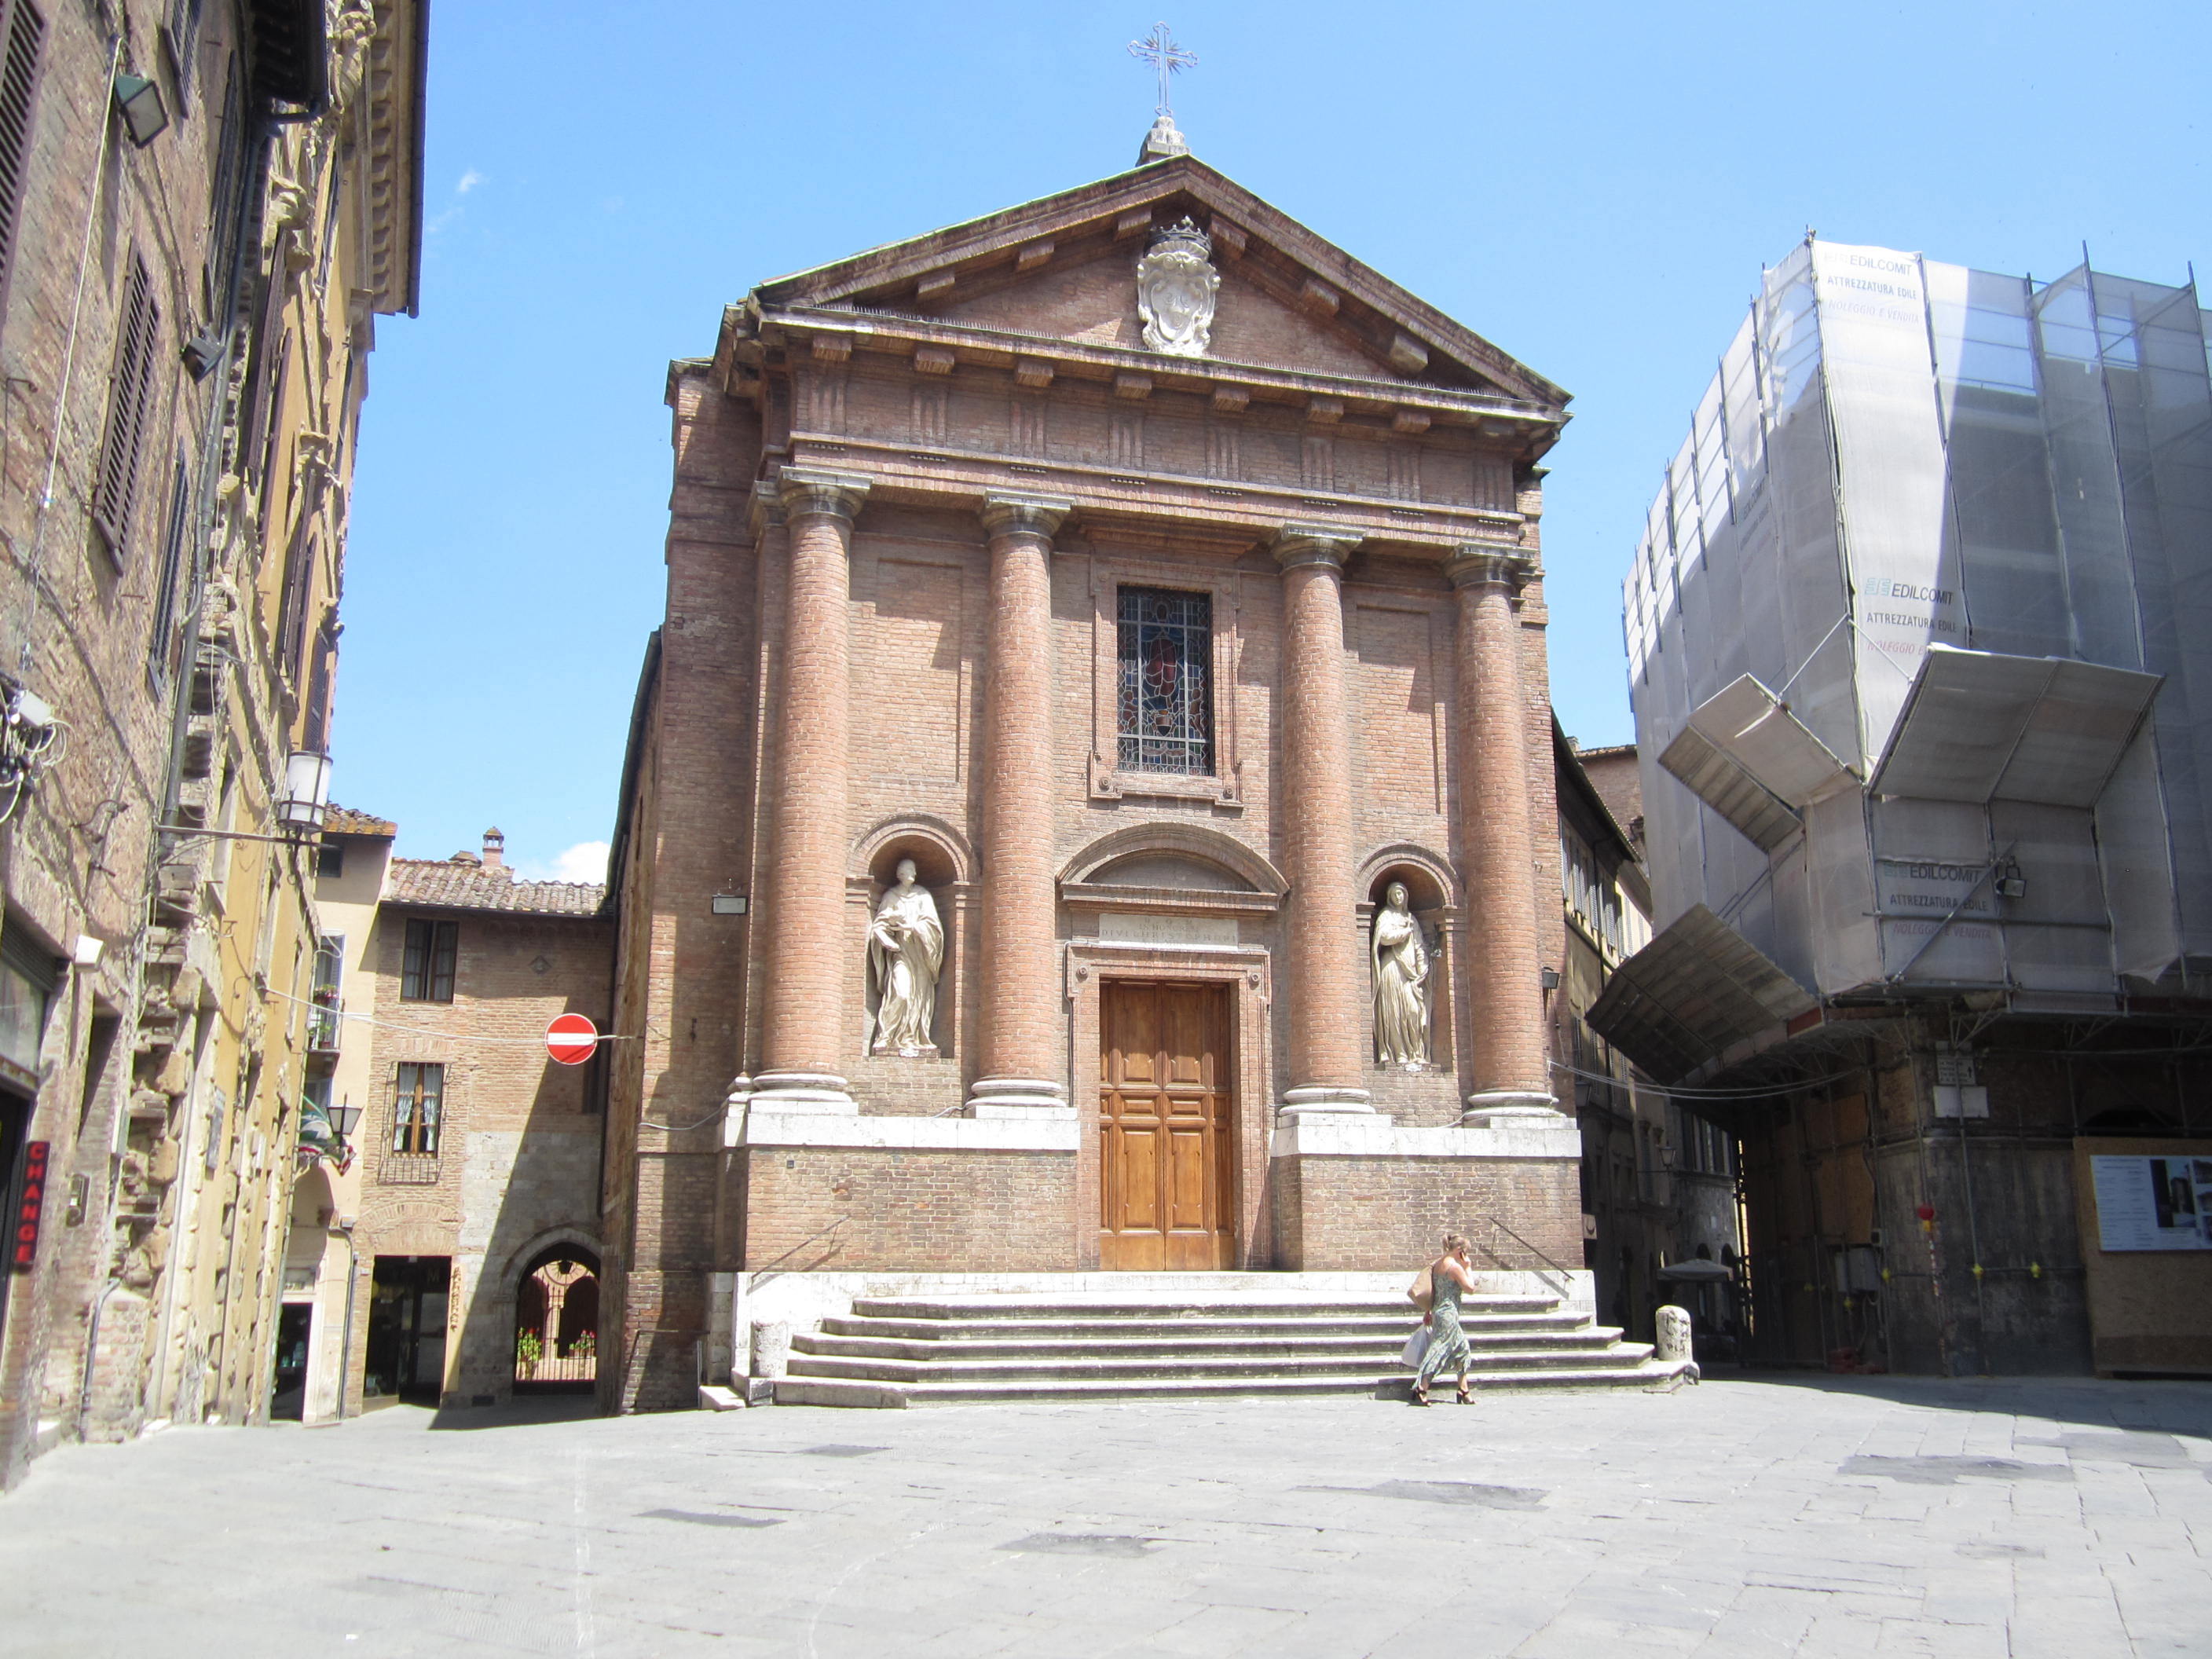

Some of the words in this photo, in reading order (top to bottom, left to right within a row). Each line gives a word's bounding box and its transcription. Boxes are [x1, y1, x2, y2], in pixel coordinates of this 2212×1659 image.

[1850, 255, 1912, 276] EDILCOMIT
[1827, 276, 1894, 295] ATTREZZATURA
[1897, 287, 1917, 299] EDILE
[1828, 299, 1876, 315] NOLEGGIO
[1892, 583, 1954, 606] EDILCOMIT
[1866, 612, 1934, 629] ATTREZZATURA
[1938, 619, 1956, 633] EDILE
[1867, 639, 1915, 654] NOLEGGIO
[1910, 865, 1982, 883] EDILCOMIT
[1890, 894, 1957, 910] ATTREZZATURA
[1954, 926, 1993, 939] VENDITA
[15, 1141, 46, 1262] CHANGE
